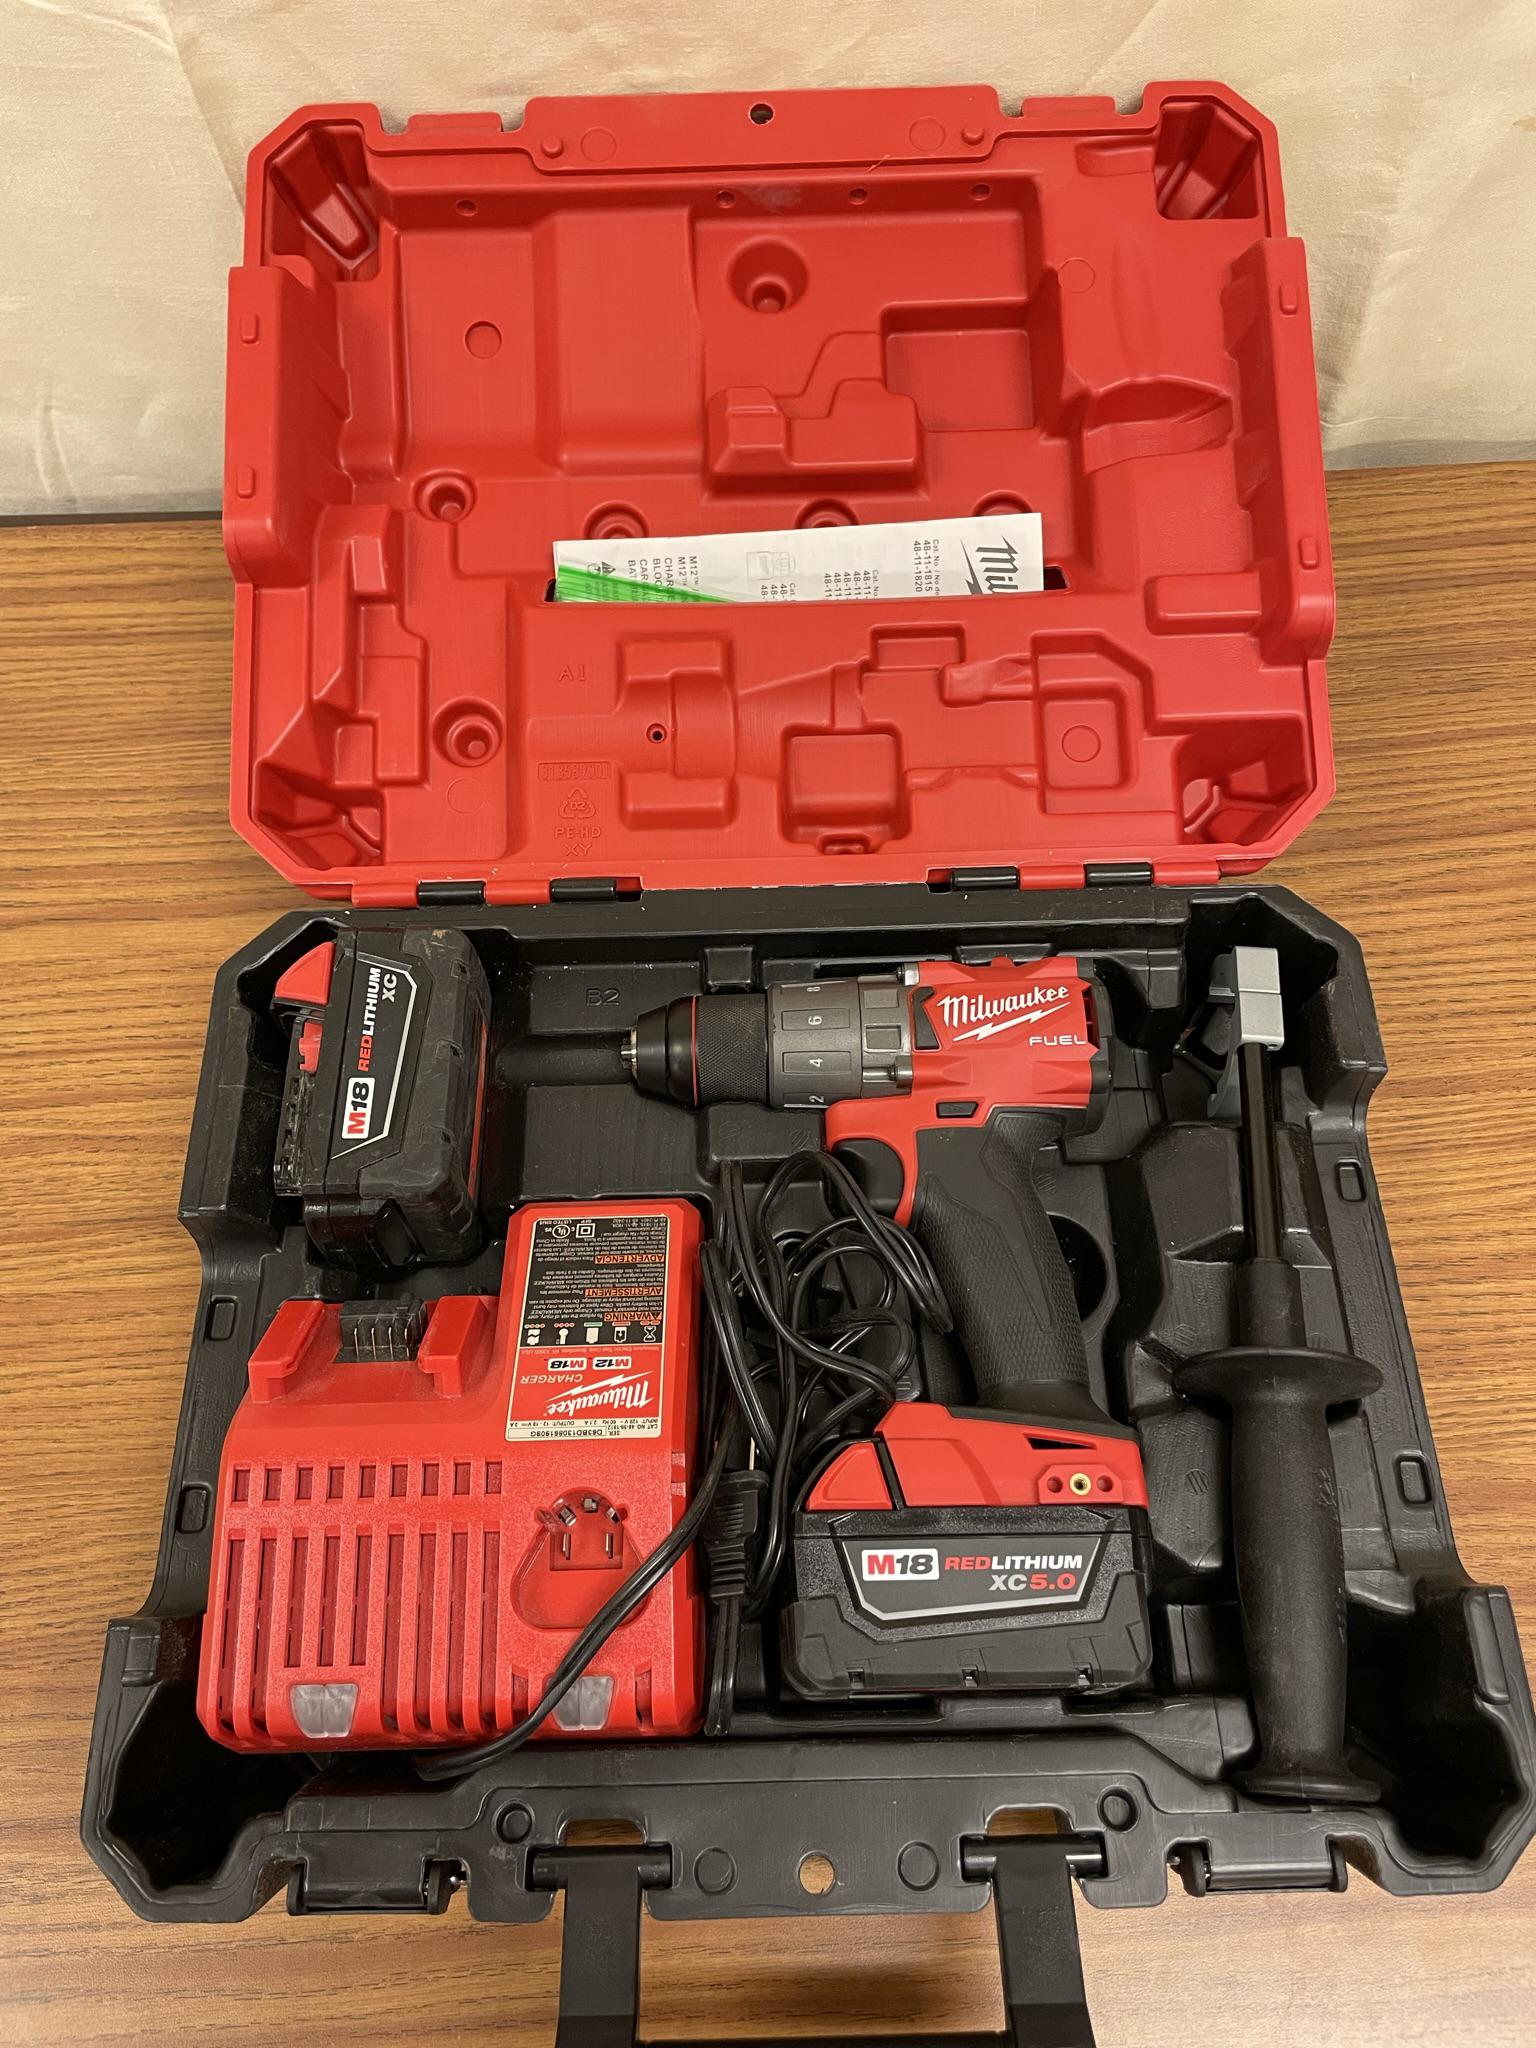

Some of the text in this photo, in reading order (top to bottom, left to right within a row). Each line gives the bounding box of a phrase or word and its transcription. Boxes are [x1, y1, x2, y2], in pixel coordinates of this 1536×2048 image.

[914, 540, 923, 593] 48-11-1820
[923, 540, 932, 592] 48-11-1815
[976, 535, 1019, 594] Mil
[382, 973, 397, 1003] XC
[586, 988, 620, 1007] B2
[936, 986, 1070, 1028] Milwaukee
[358, 967, 381, 1072] REDLITHIUM
[808, 1015, 823, 1026] 6
[1029, 1035, 1086, 1046] FUEL
[809, 1058, 823, 1068] 4
[347, 1081, 370, 1134] M18
[809, 1095, 824, 1103] 2
[596, 1254, 662, 1263] ADVERTENCIA
[586, 1286, 661, 1296] AVERTISSEMENT
[605, 1311, 651, 1320] WARNING
[550, 1358, 630, 1369] M12 M18
[520, 1373, 583, 1385] CHARGER
[547, 1380, 654, 1417] Milwaukee
[867, 1554, 1083, 1576] M18 REDLITHIUM
